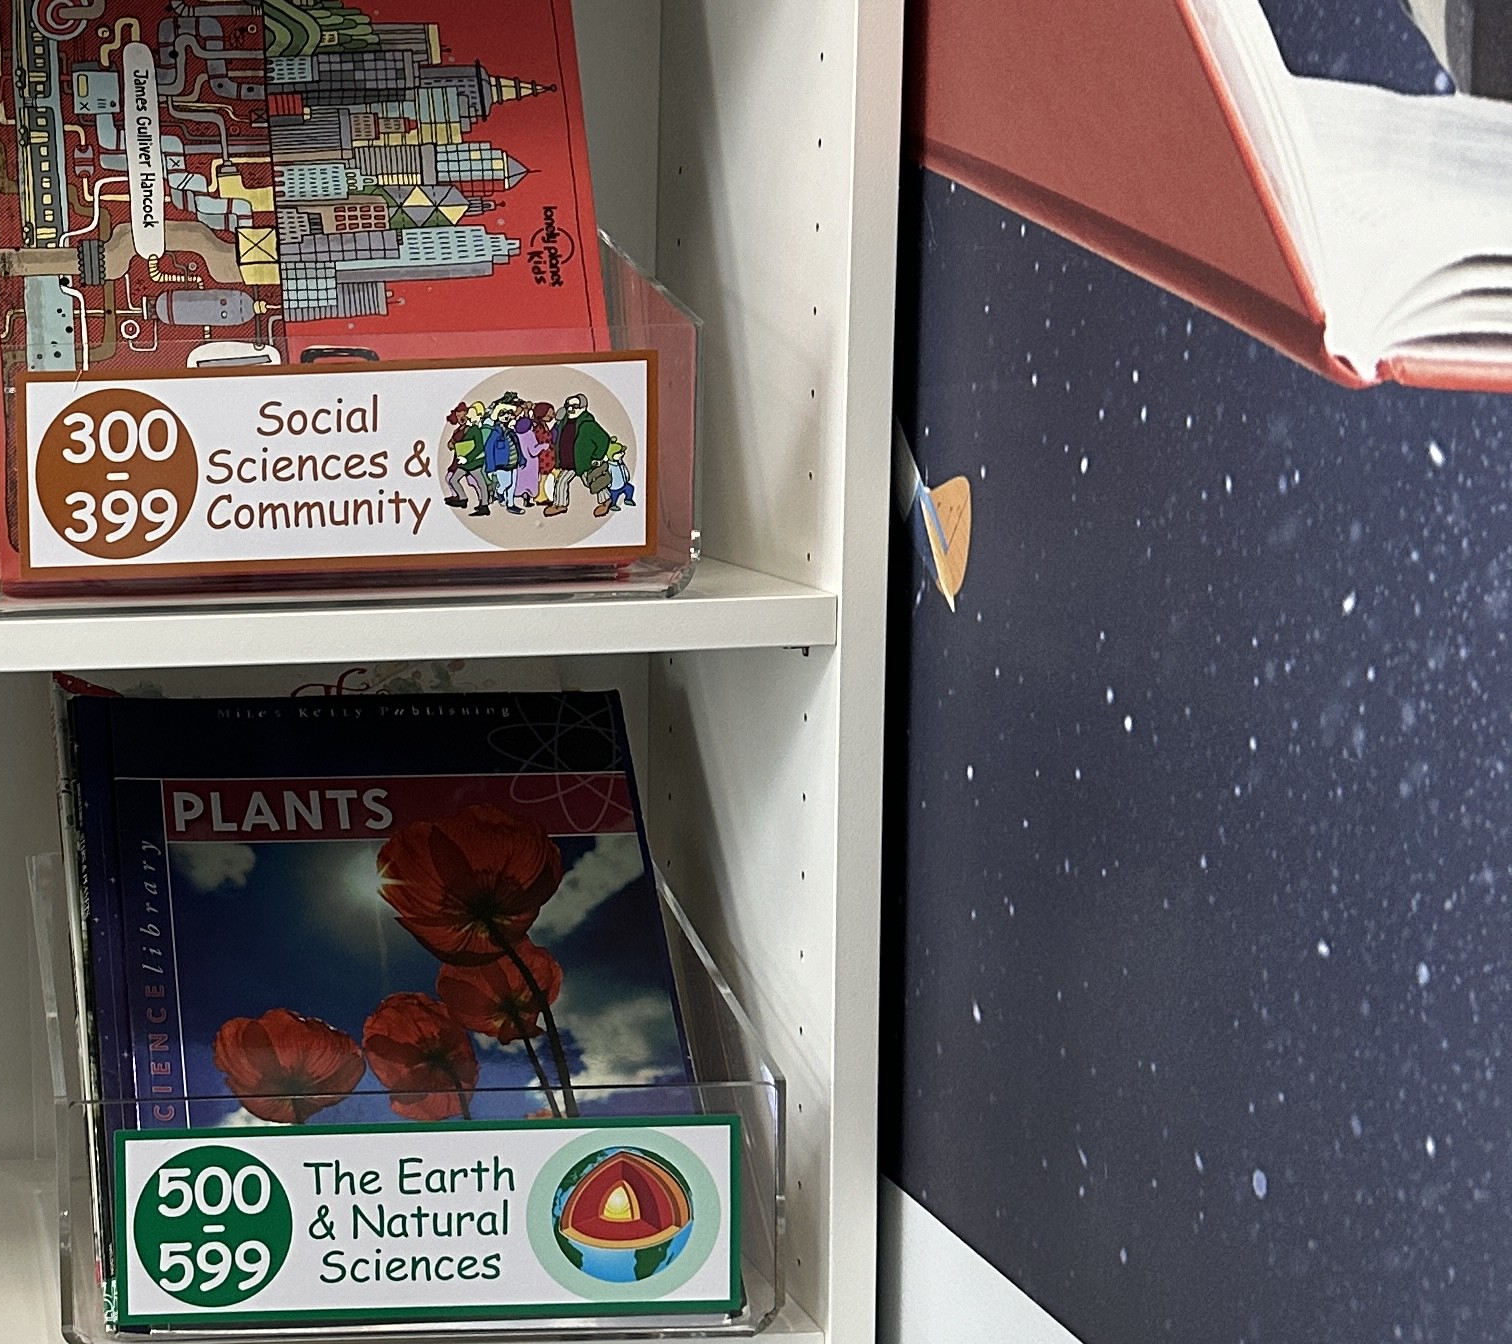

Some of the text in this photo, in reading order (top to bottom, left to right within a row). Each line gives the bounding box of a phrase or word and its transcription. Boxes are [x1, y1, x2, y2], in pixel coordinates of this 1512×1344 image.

[133, 69, 160, 229] James Gulliver Hancock
[527, 250, 547, 285] Kids
[541, 205, 564, 287] lonely planet
[62, 408, 178, 464] 300
[256, 394, 378, 436] Social
[206, 439, 432, 485] Sciences &
[64, 488, 179, 543] 399
[206, 489, 432, 536] Community
[172, 787, 394, 833] PLANTS
[158, 1164, 271, 1218] 500
[303, 1155, 515, 1196] The Earth
[308, 1199, 508, 1241] & Natural
[159, 1240, 271, 1293] 599
[319, 1248, 501, 1284] Sciences
